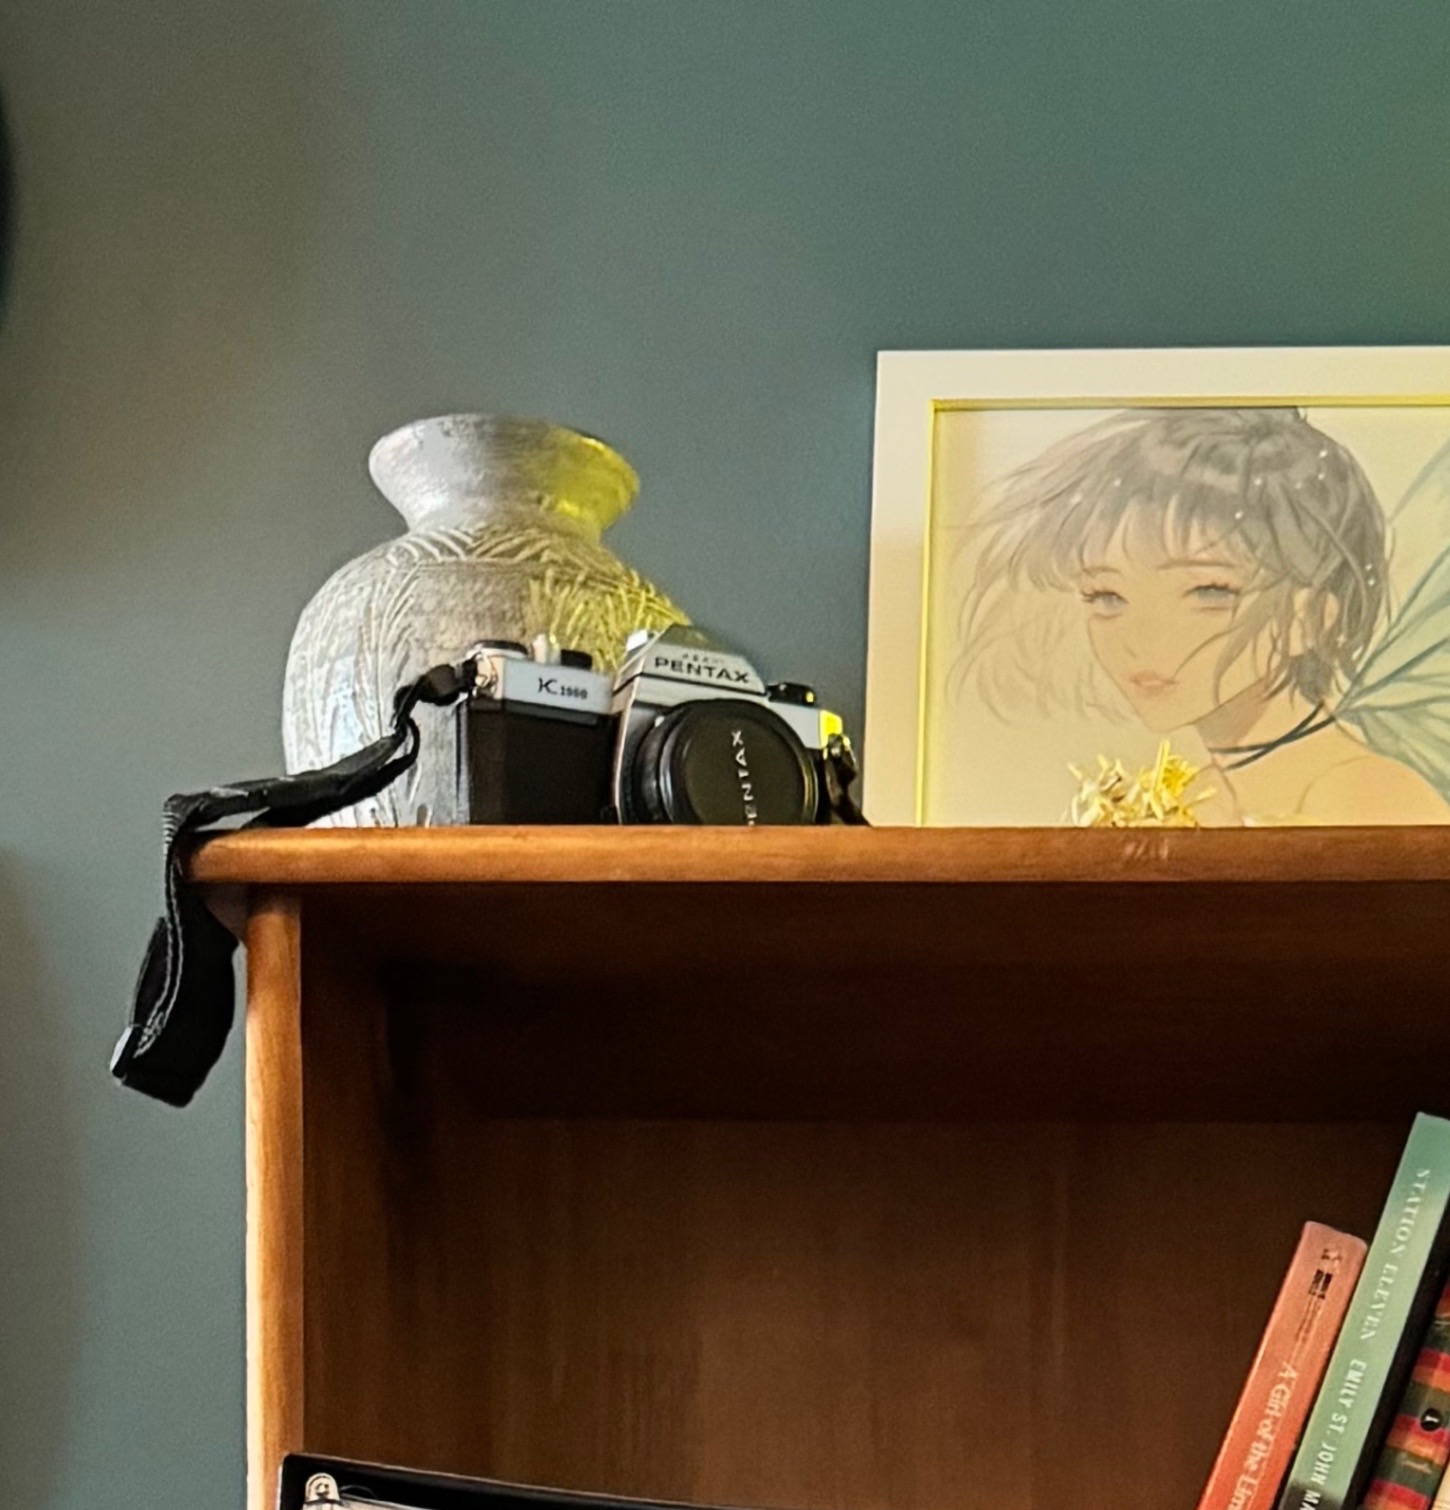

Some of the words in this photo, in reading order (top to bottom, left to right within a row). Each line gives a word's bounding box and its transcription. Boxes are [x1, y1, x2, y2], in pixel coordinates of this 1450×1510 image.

[655, 656, 750, 684] PENTAX
[1336, 1358, 1366, 1409] EMILY
[1325, 1411, 1347, 1439] ST.
[1308, 1441, 1338, 1486] JOHN
